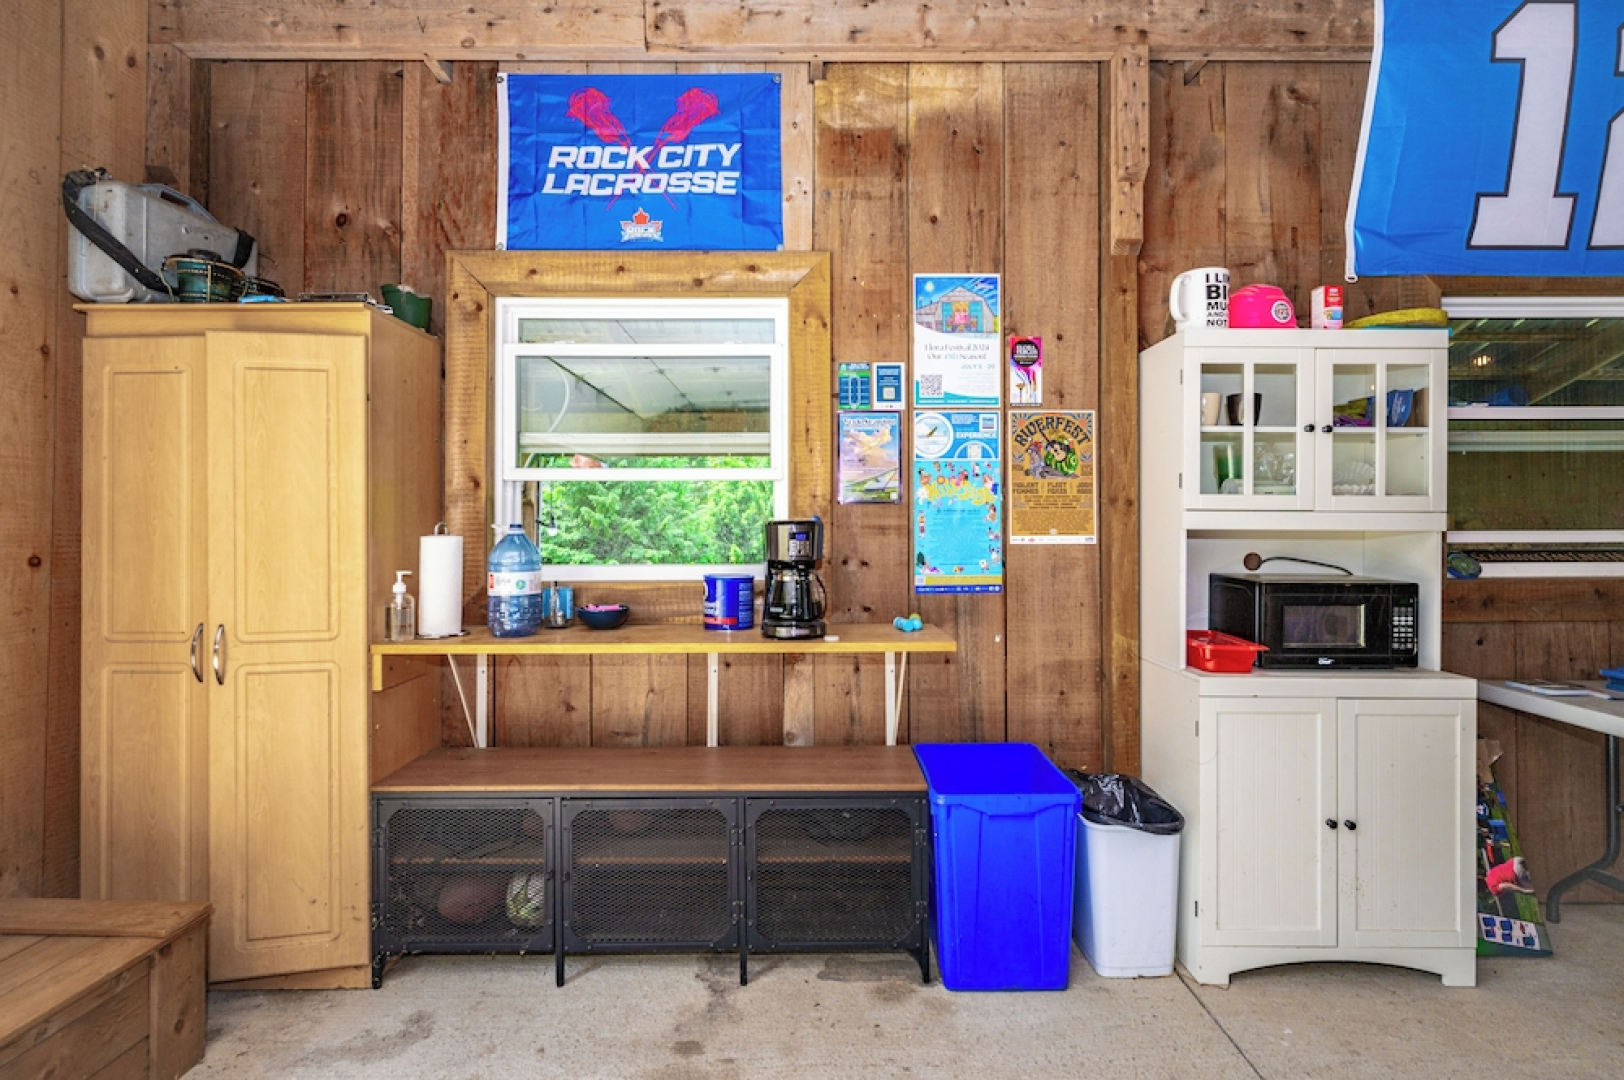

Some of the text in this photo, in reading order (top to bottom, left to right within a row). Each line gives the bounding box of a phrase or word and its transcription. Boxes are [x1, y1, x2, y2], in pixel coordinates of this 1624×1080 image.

[548, 143, 743, 170] ROCK CITY
[541, 171, 741, 196] LACROSSE
[1205, 273, 1210, 283] I
